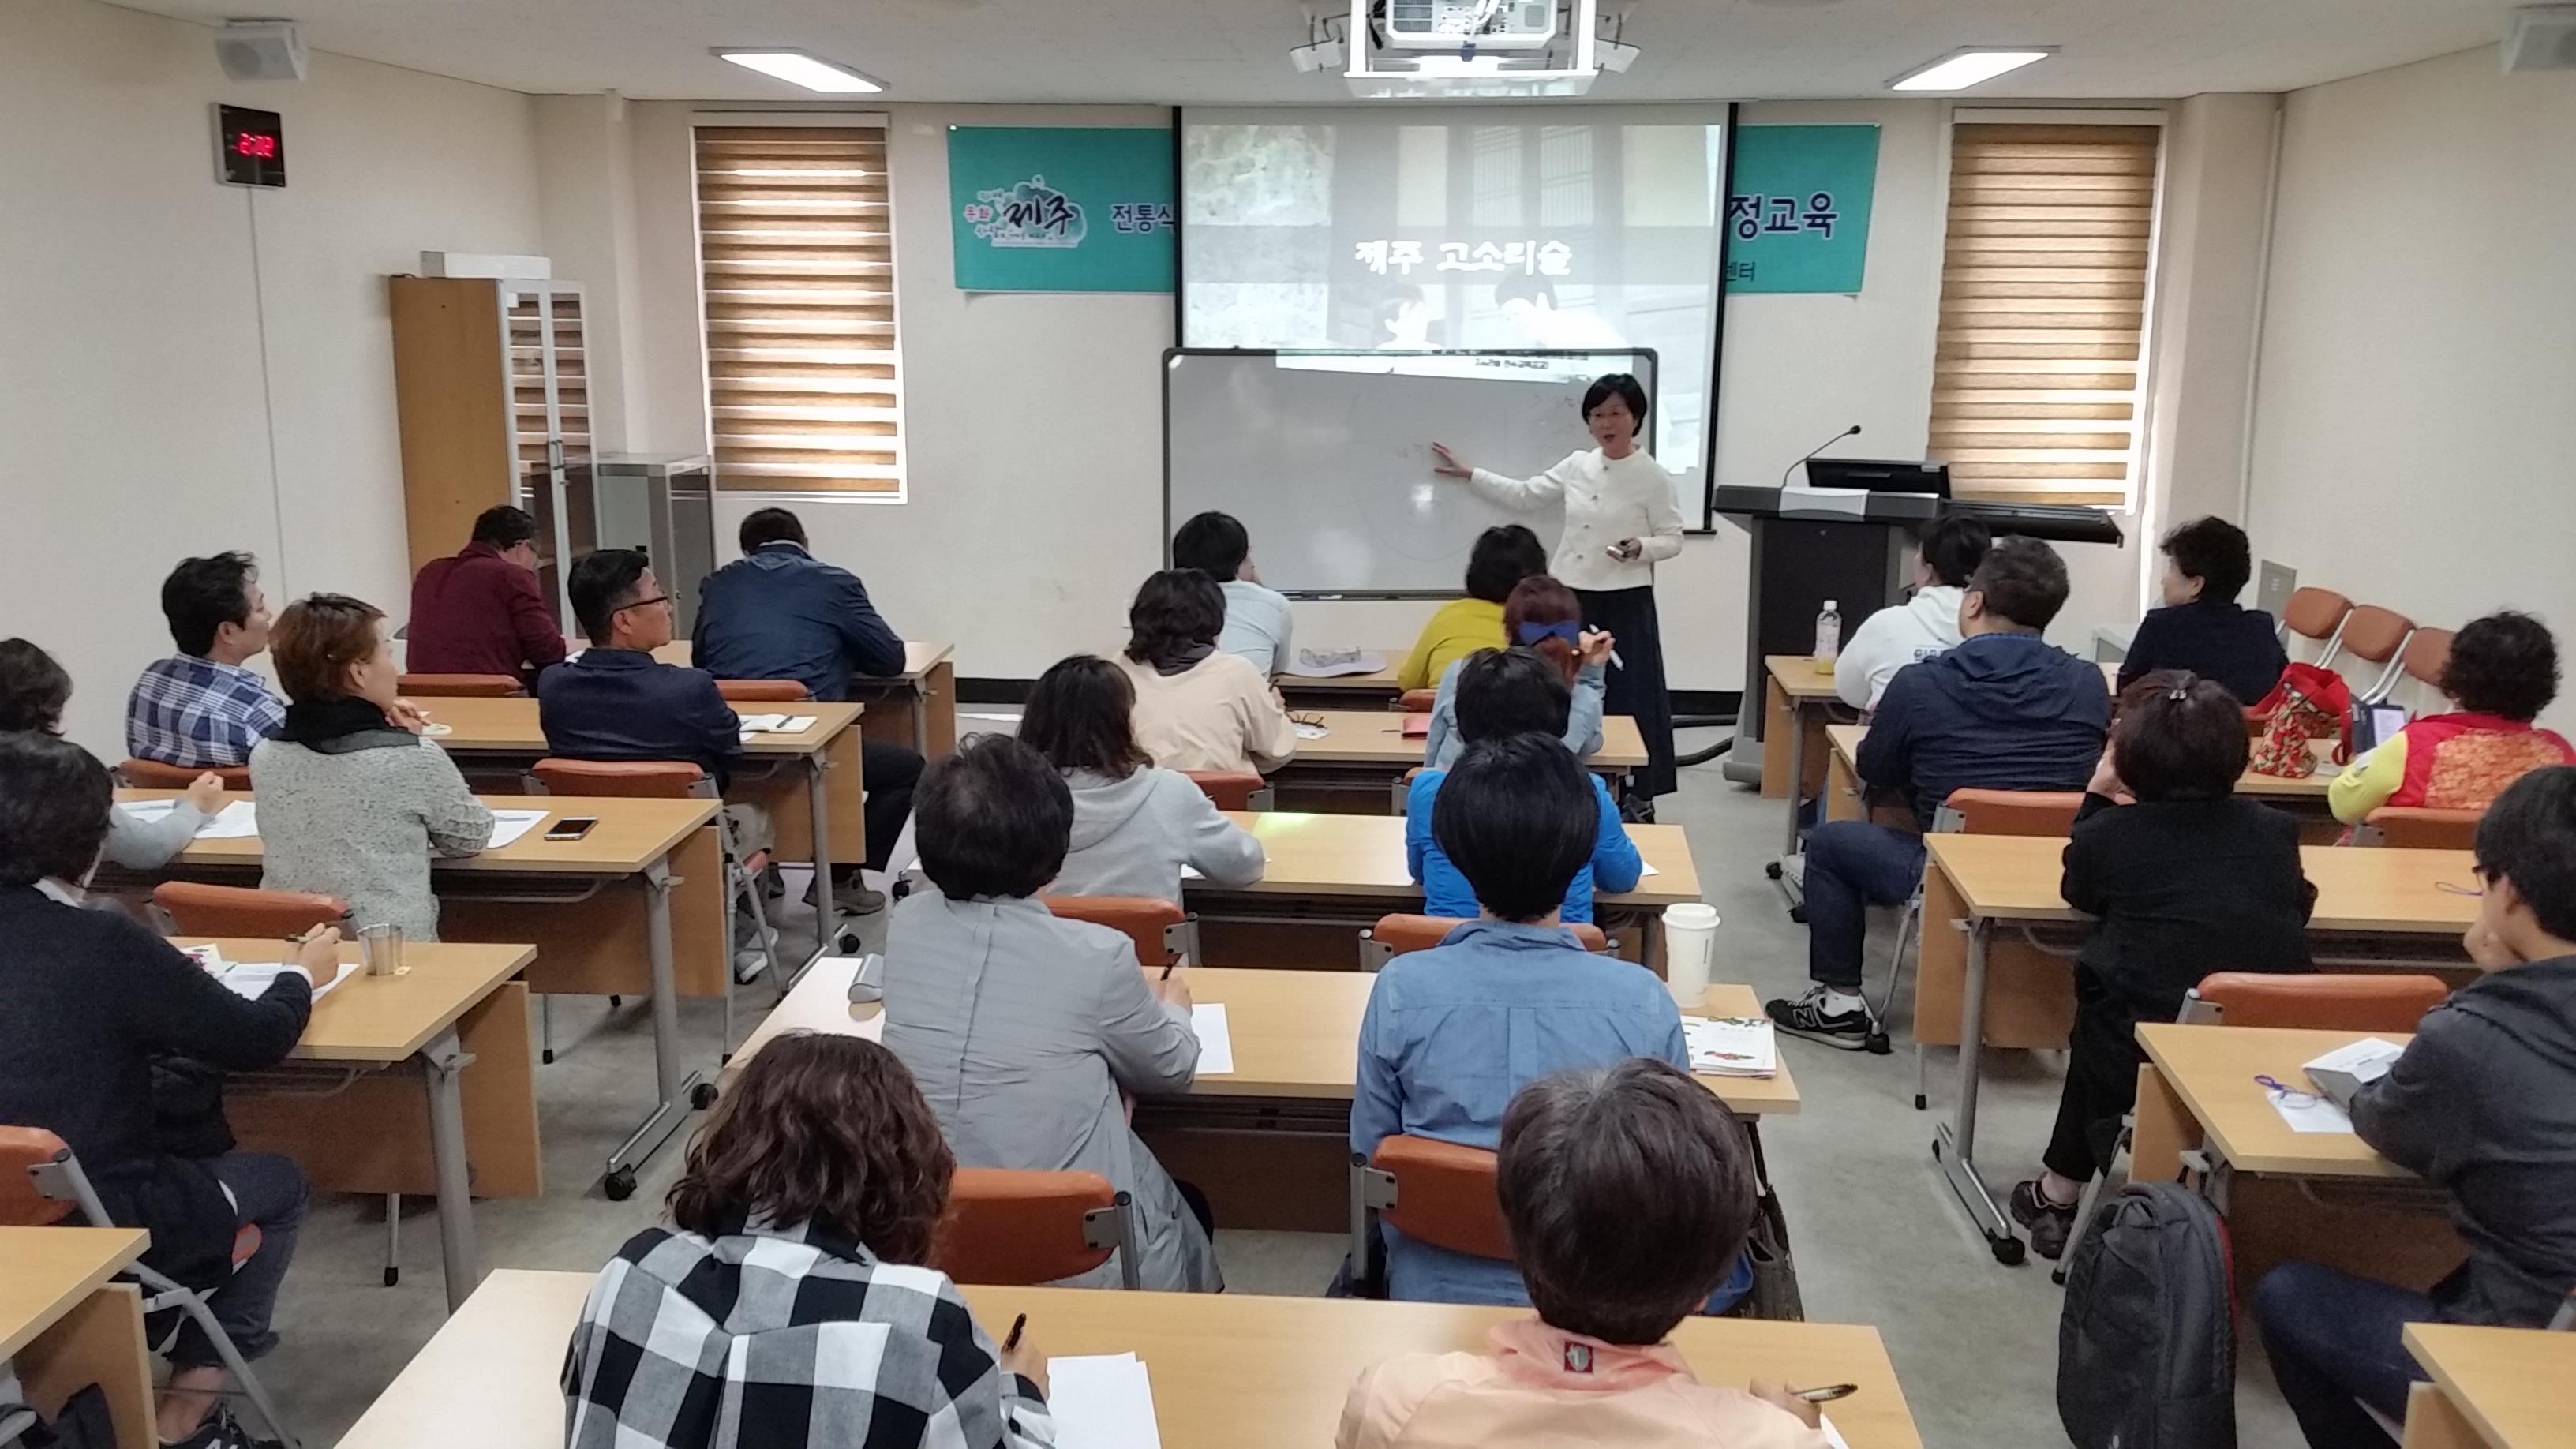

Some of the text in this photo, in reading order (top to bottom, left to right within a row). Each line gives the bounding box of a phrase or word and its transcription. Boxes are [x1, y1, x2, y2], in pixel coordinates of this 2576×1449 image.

[1003, 195, 1074, 236] 제주
[1354, 239, 1573, 276] 제주 고소리술
[1792, 1007, 1818, 1028] N
